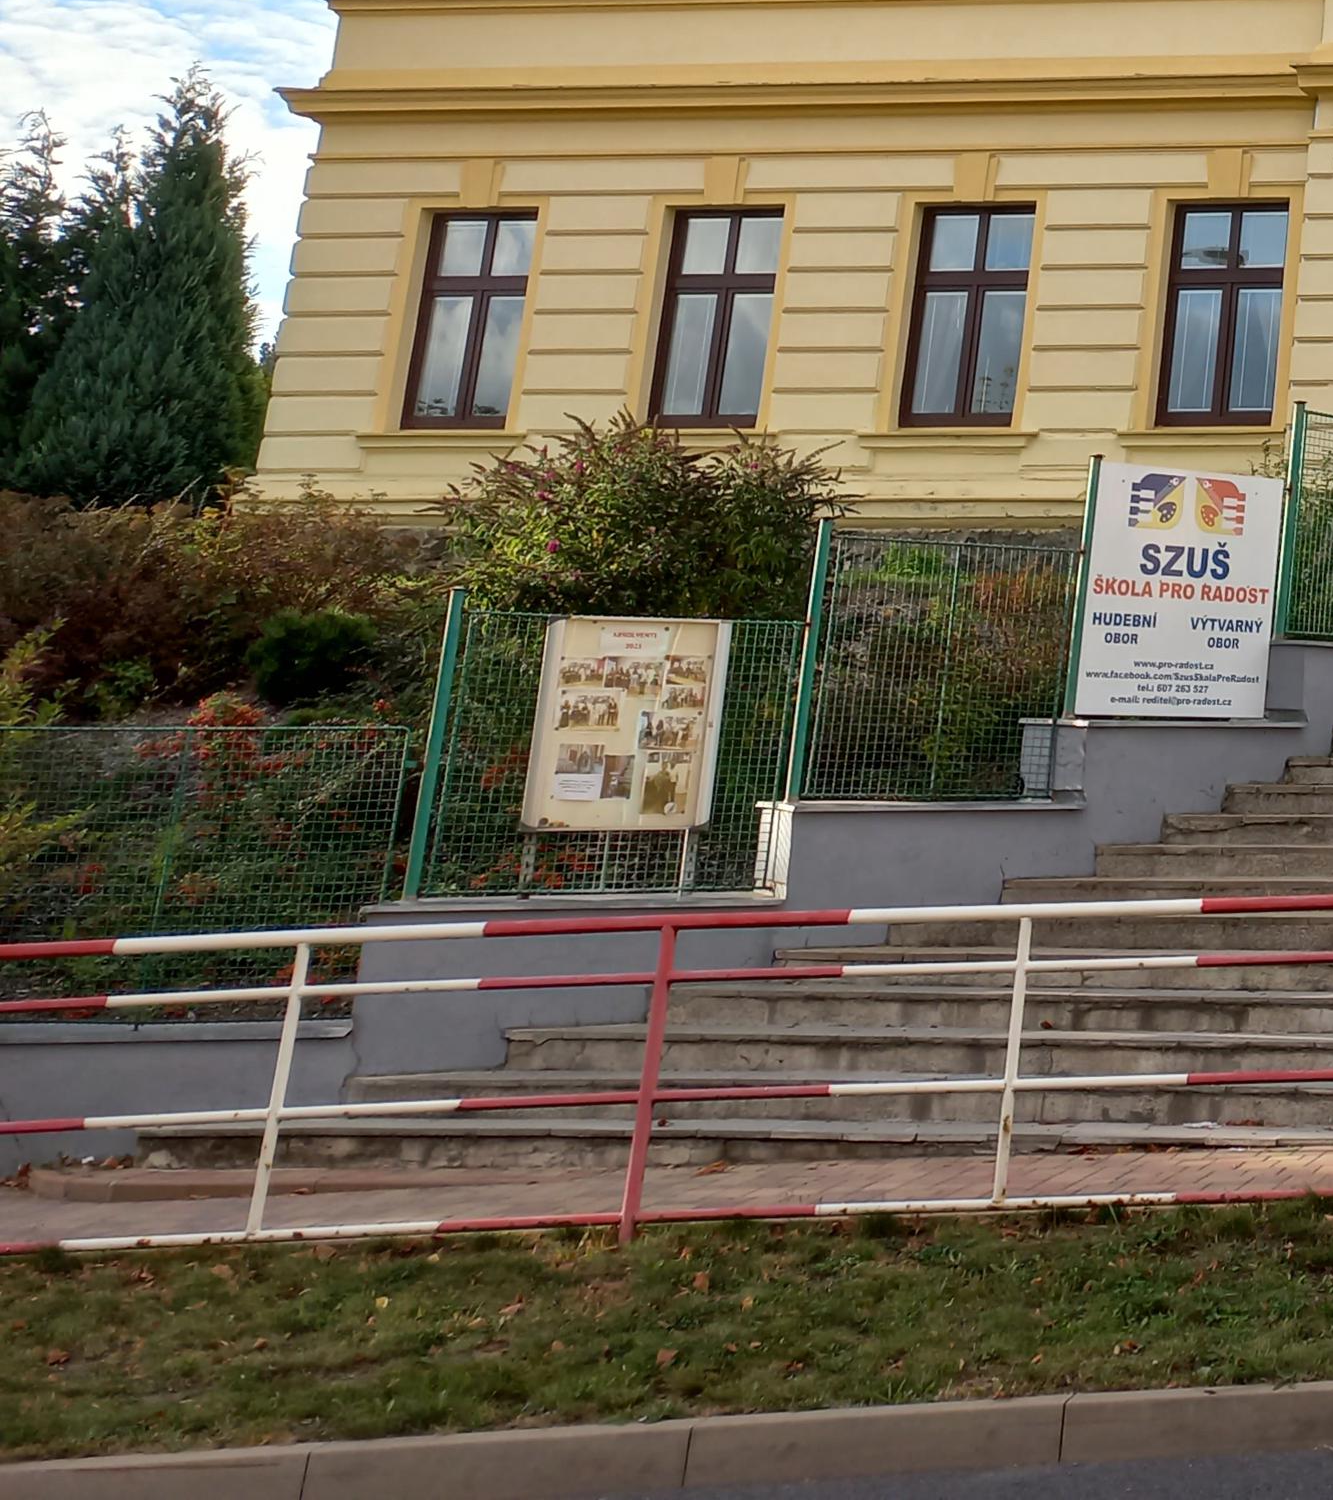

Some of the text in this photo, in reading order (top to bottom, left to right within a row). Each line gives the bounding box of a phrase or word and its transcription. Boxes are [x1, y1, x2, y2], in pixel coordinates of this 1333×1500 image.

[1140, 541, 1230, 580] SZUŠ
[1093, 574, 1270, 605] ŠKOLA PRO RADOST
[1092, 611, 1158, 628] HUDEBNÍ
[1190, 615, 1263, 634] VÝTVARNÝ
[1104, 632, 1139, 645] OBOR
[1207, 636, 1240, 649] OBOR
[1133, 660, 1214, 670] www.pro-radost.cz
[1193, 685, 1209, 694] 527
